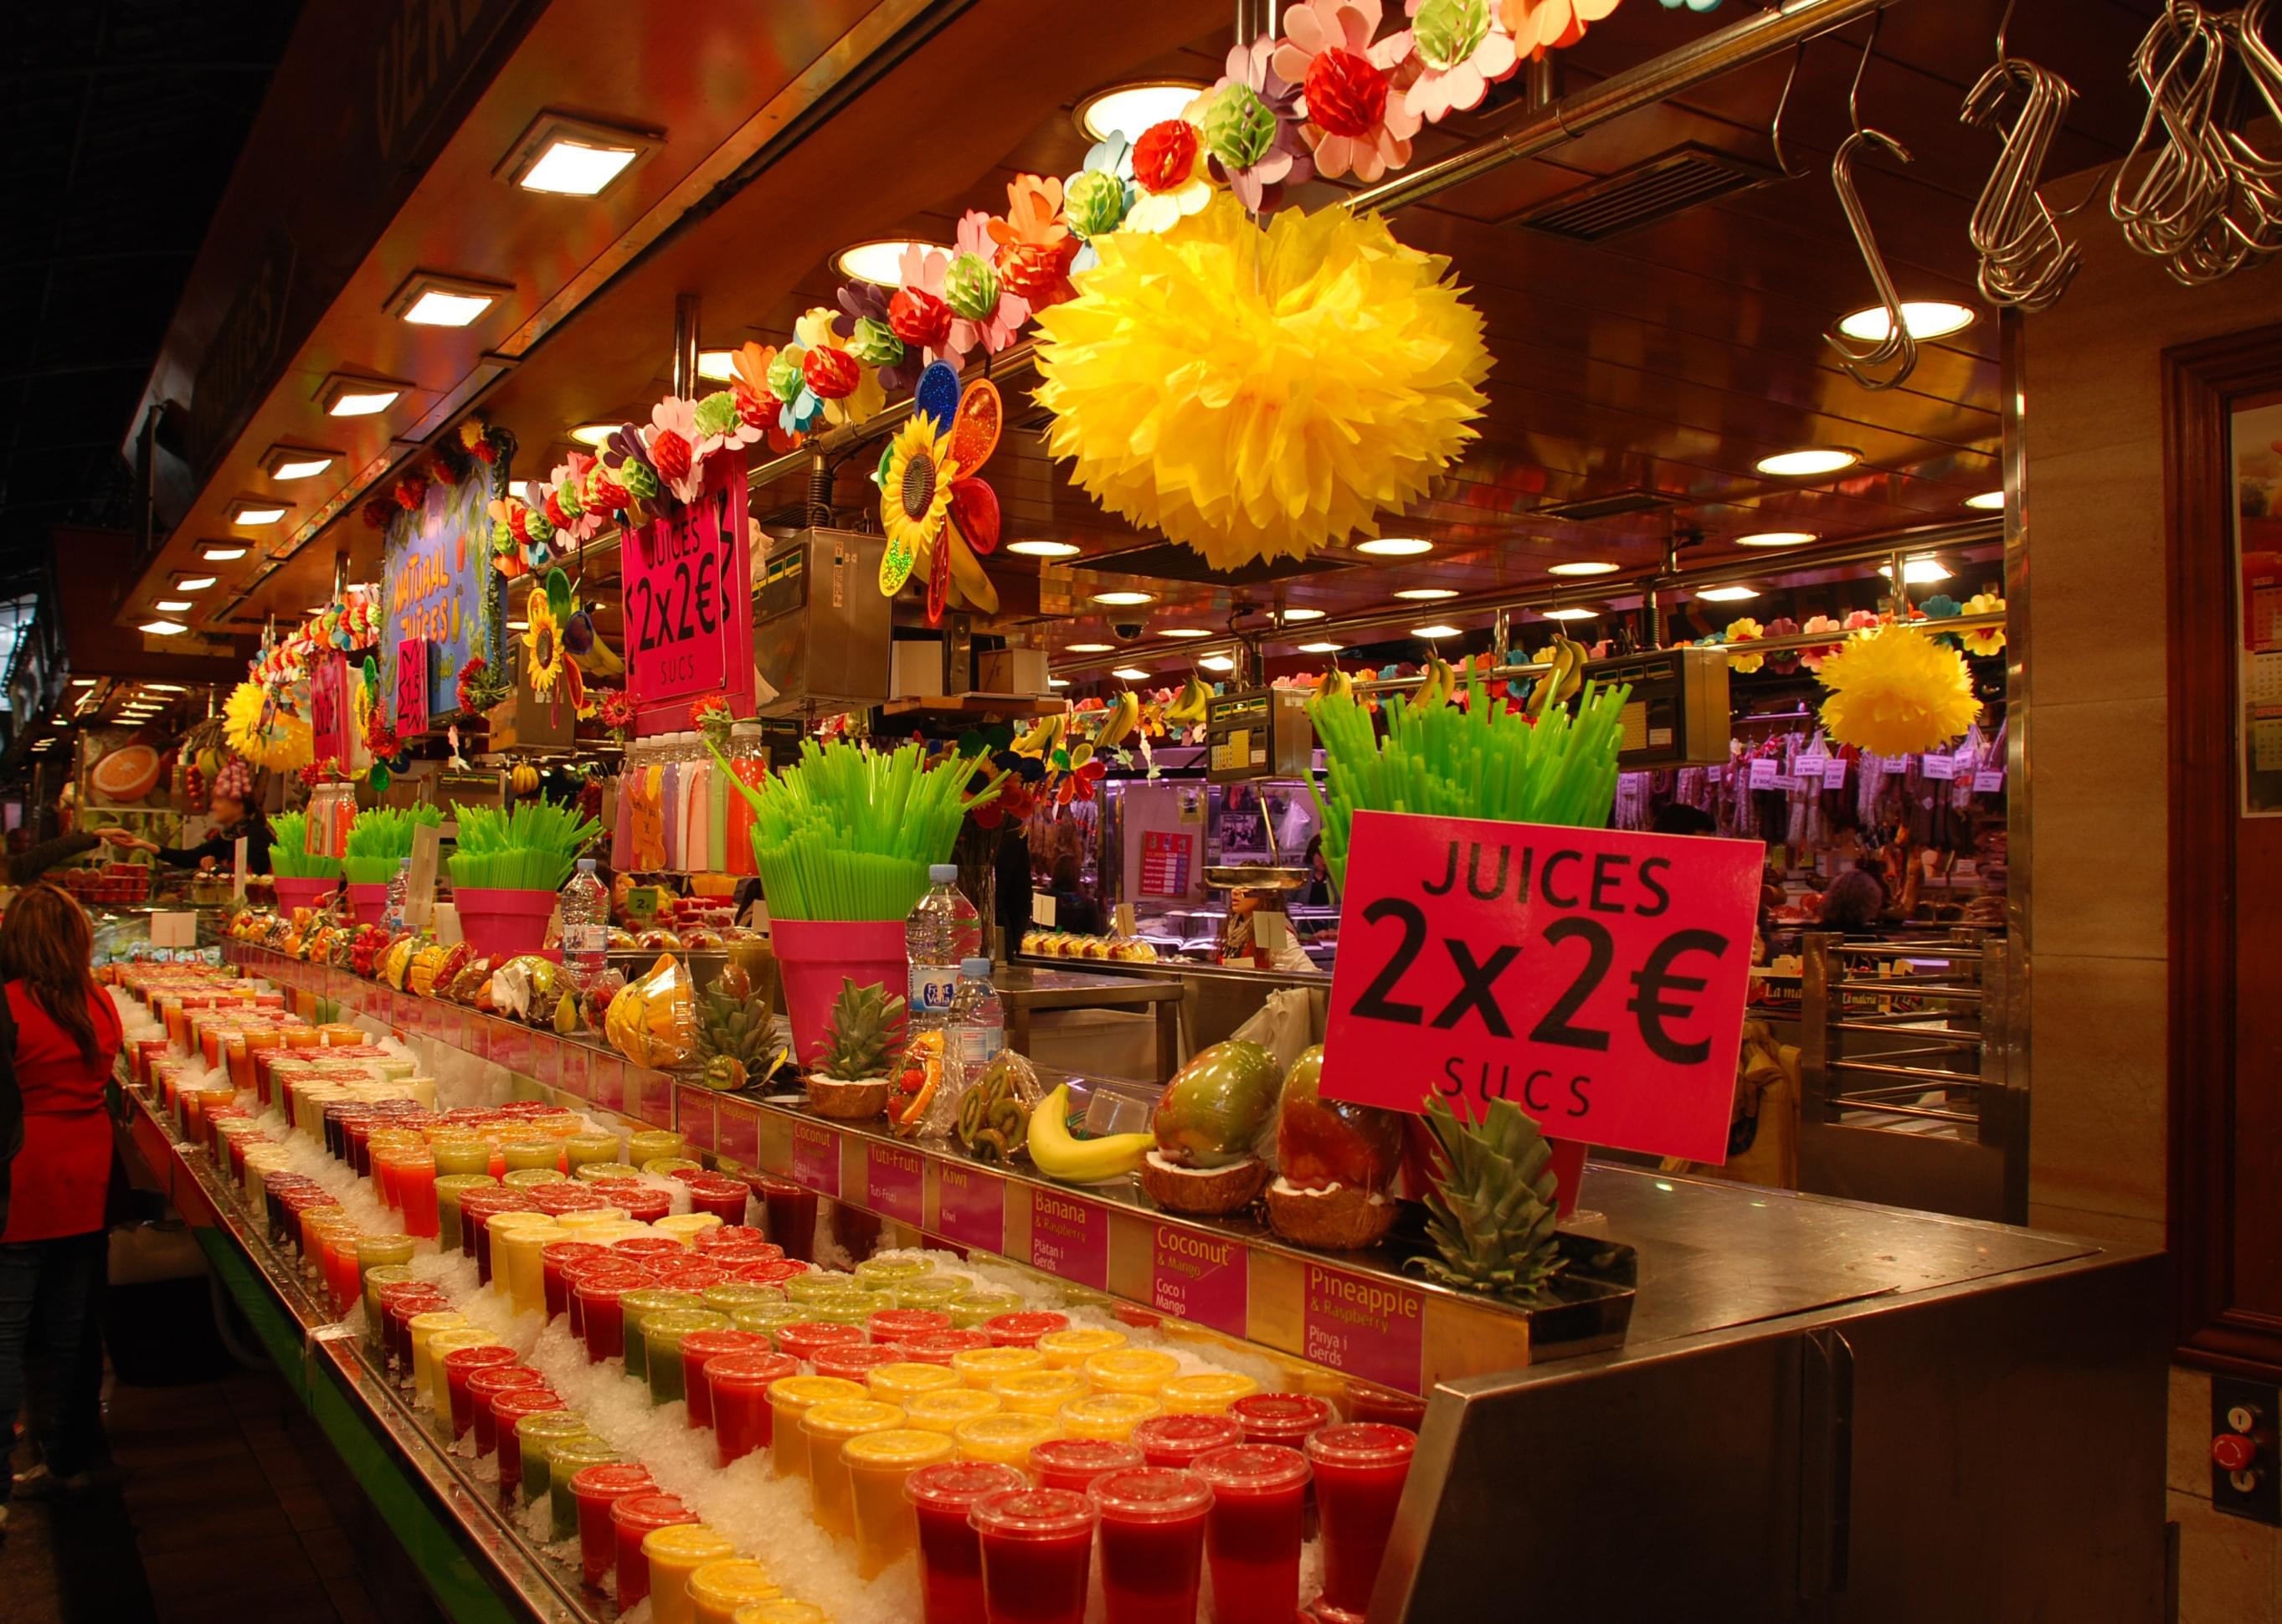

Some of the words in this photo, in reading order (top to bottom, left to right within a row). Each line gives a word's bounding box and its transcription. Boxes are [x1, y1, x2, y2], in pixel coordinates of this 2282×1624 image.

[648, 516, 701, 570] JUICES
[393, 542, 450, 616] NATURAL
[636, 552, 717, 653] 2x2€
[660, 653, 695, 686] SUCS
[1421, 840, 1672, 917] JUICES
[1349, 897, 1730, 1066] 2x2€
[1442, 1056, 1591, 1118] SUCS
[795, 1122, 831, 1148] Coconut
[870, 1143, 919, 1174] Tuti-Fruti
[942, 1164, 968, 1189] Kiwi
[870, 1184, 898, 1204] Tuti-Fruti
[1036, 1190, 1087, 1225] Banana
[942, 1209, 957, 1224] Kiwi
[1035, 1215, 1042, 1228] &
[1044, 1217, 1087, 1244] Raspberry
[1033, 1252, 1056, 1272] Gerds
[1158, 1226, 1230, 1267] Coconut
[1157, 1251, 1165, 1267] &
[1167, 1256, 1201, 1279] Mango
[1156, 1278, 1180, 1298] Coco
[1311, 1267, 1419, 1318] Pineapple
[1155, 1293, 1186, 1317] Mango
[1310, 1296, 1320, 1312] &
[1323, 1299, 1389, 1335] Raspberry
[1308, 1325, 1340, 1349] Pinya
[1308, 1342, 1343, 1367] Gerds
